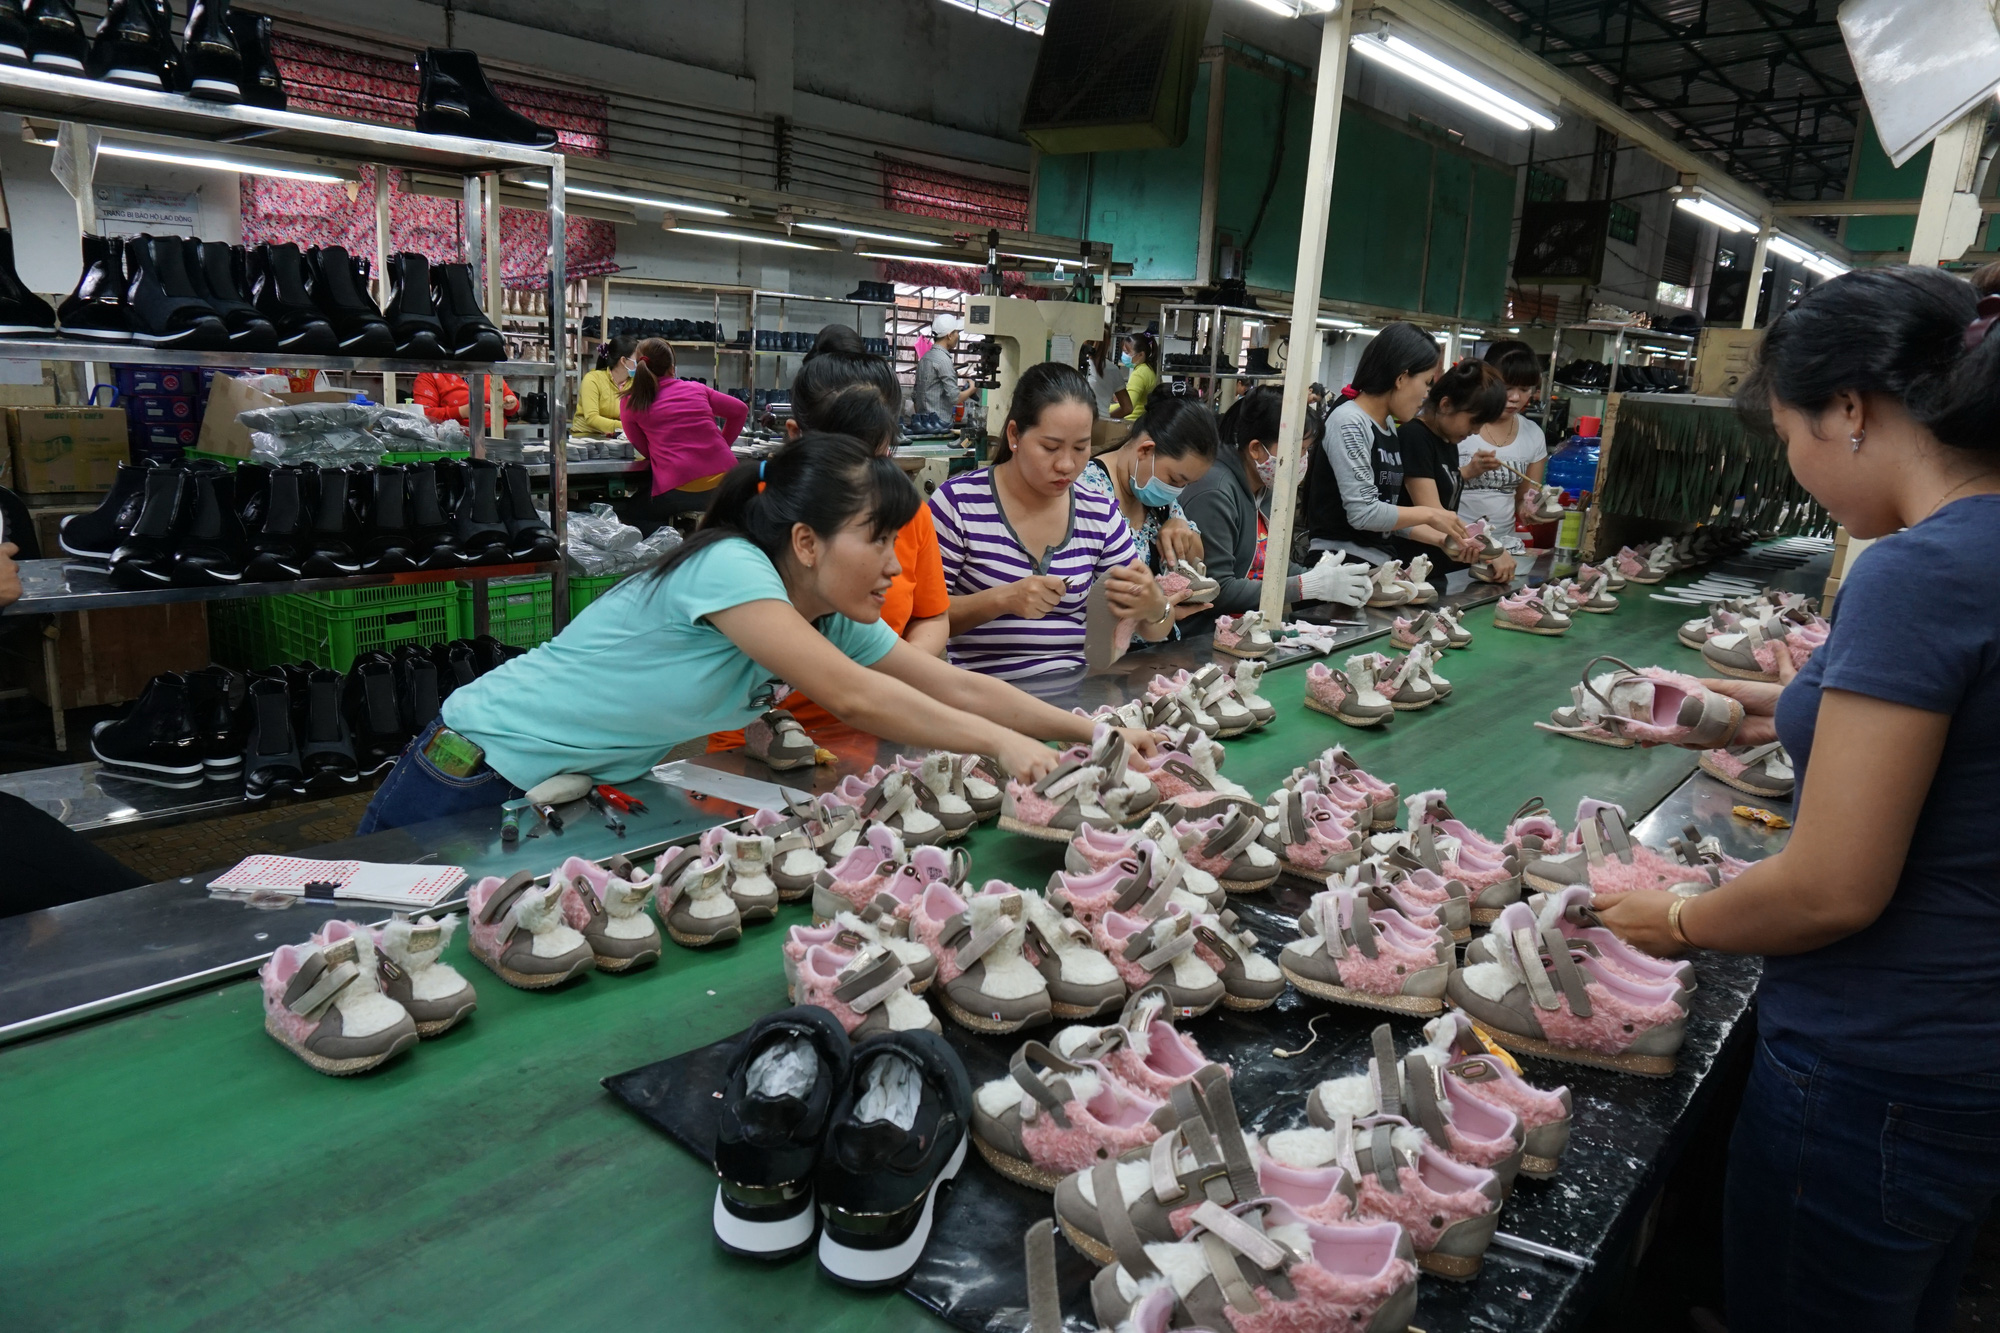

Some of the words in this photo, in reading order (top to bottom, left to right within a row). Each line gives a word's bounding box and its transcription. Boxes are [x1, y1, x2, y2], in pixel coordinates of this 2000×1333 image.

[102, 209, 126, 218] TRANG
[160, 214, 173, 222] LAO
[1341, 422, 1367, 461] THIS
